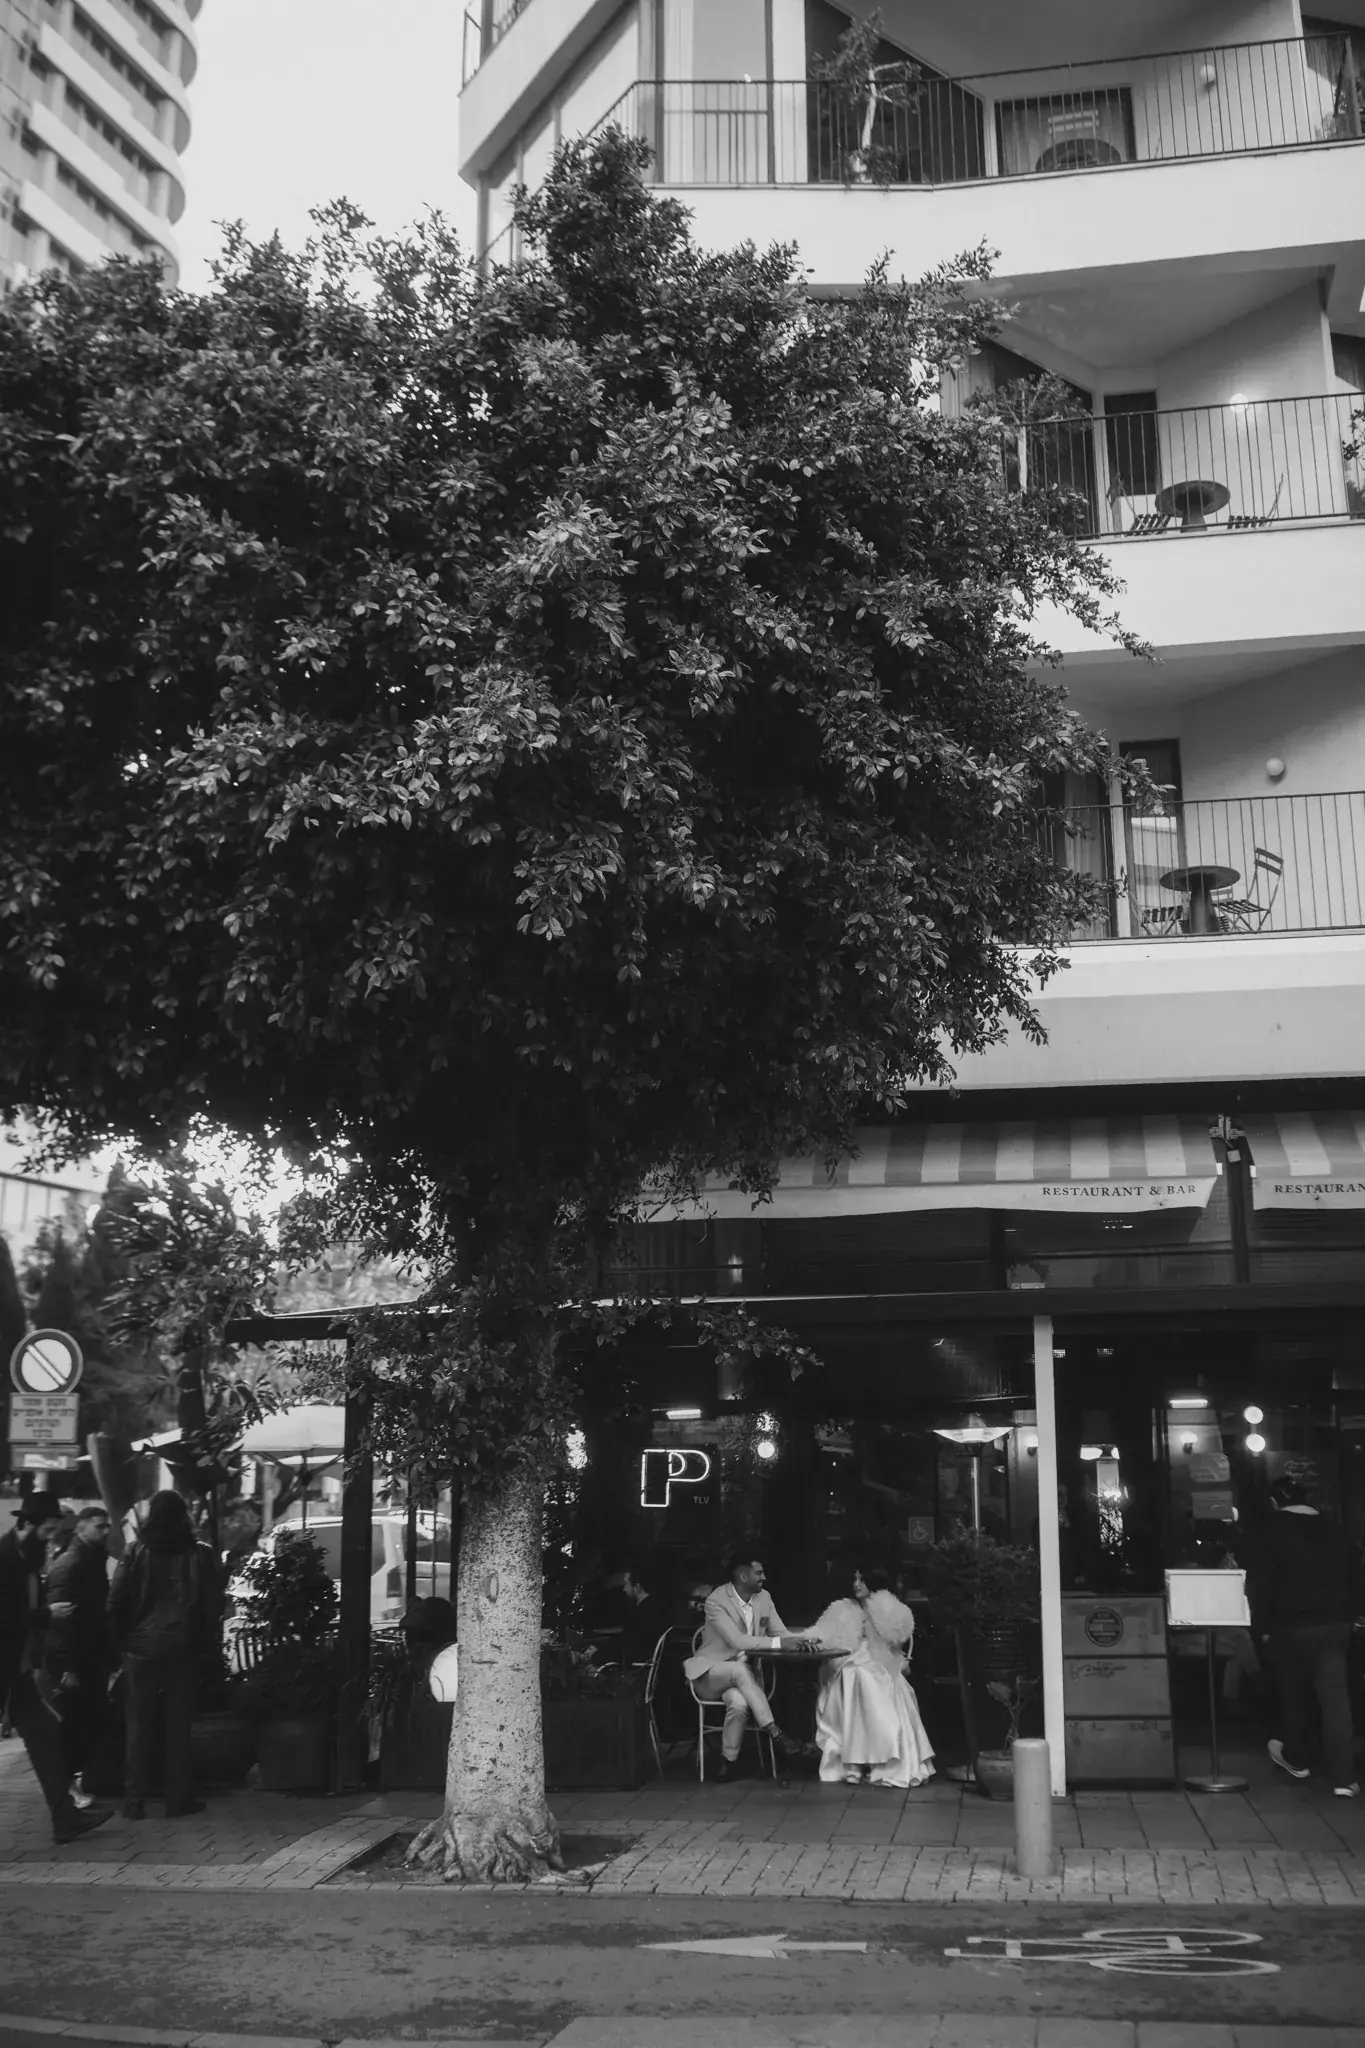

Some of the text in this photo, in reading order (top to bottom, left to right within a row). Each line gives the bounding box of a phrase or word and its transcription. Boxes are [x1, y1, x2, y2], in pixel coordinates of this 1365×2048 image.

[1042, 1184, 1197, 1197] RESTAURANT & BAR
[641, 1448, 710, 1507] P
[693, 1496, 710, 1504] TLV
